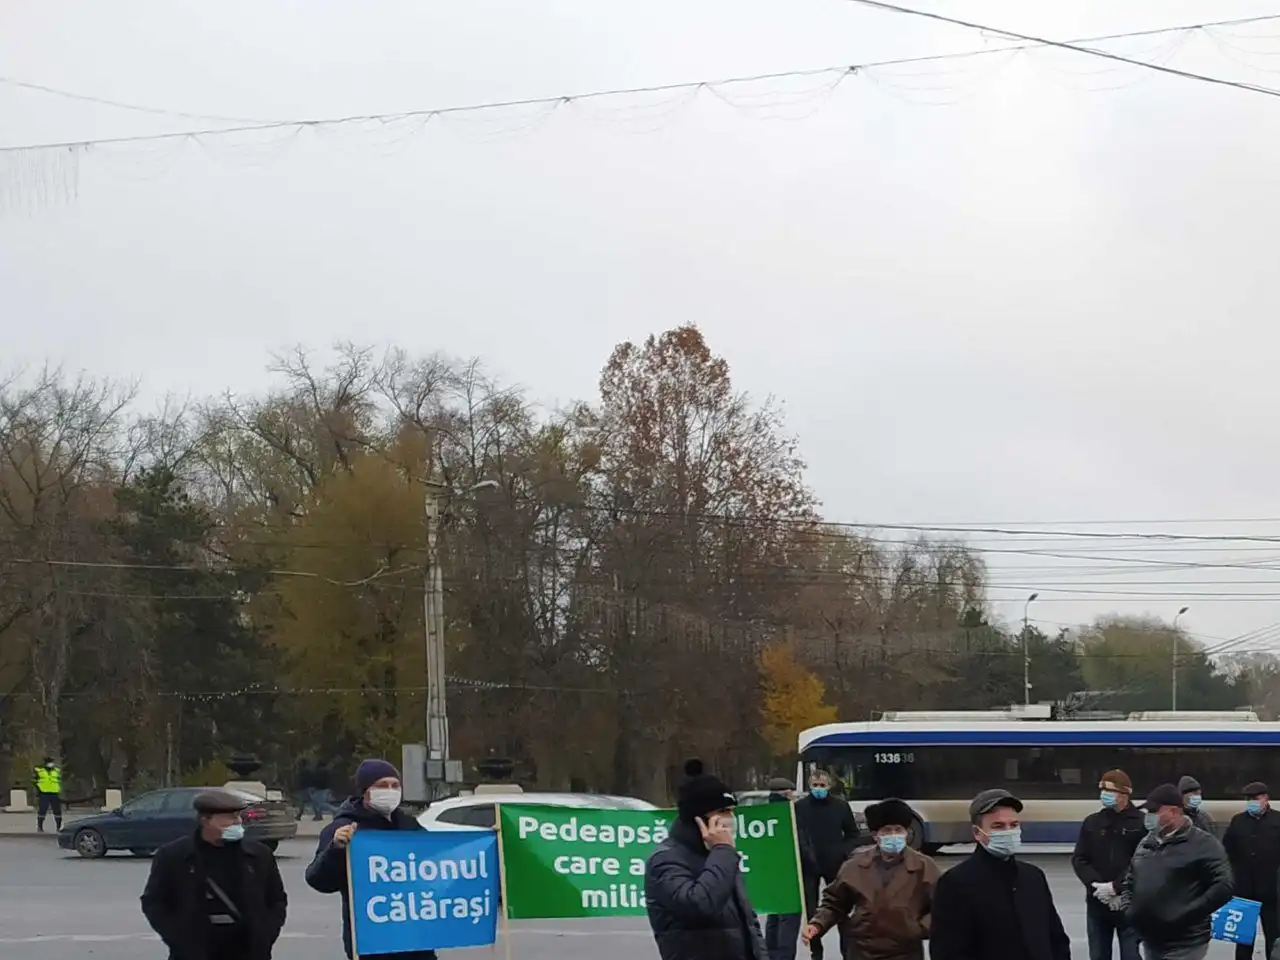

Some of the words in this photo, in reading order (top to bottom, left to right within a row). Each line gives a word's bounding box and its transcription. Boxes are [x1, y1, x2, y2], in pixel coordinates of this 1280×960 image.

[518, 815, 669, 848] Pedeapsă
[738, 813, 779, 839] lor
[367, 850, 488, 883] Raionul
[553, 855, 620, 875] care
[629, 857, 646, 875] a
[366, 888, 490, 925] Călărași
